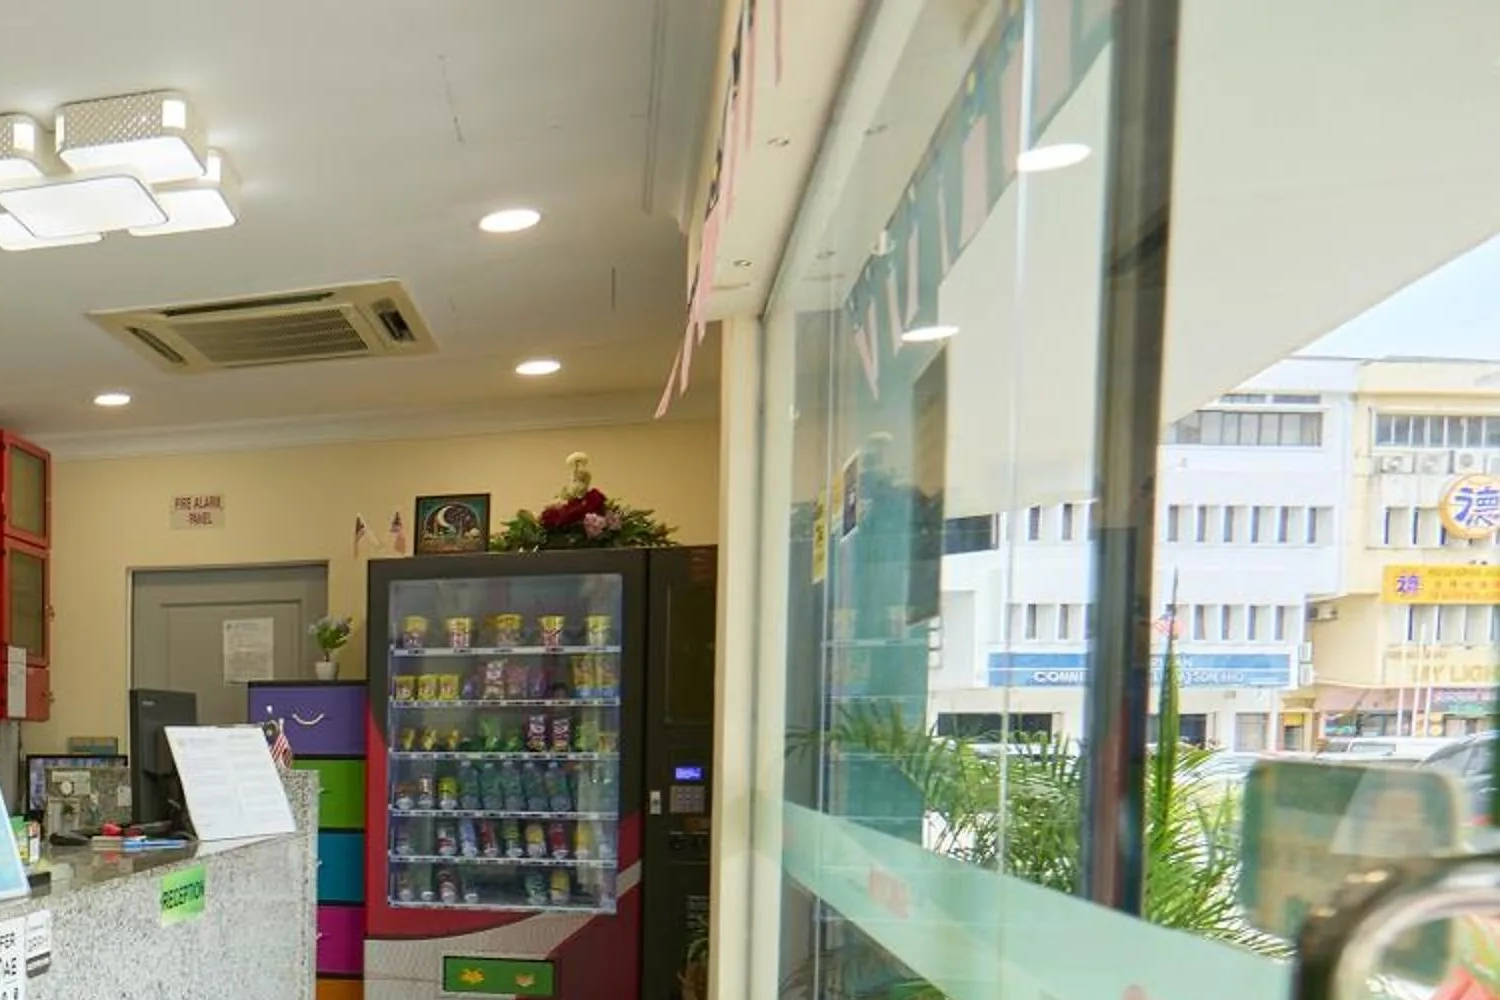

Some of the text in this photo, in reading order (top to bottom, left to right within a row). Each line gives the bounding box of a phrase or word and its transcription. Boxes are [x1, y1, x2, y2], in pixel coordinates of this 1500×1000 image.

[175, 495, 223, 511] FIRE ALARM
[189, 511, 213, 525] PANEL
[162, 881, 205, 910] RECEPTION
